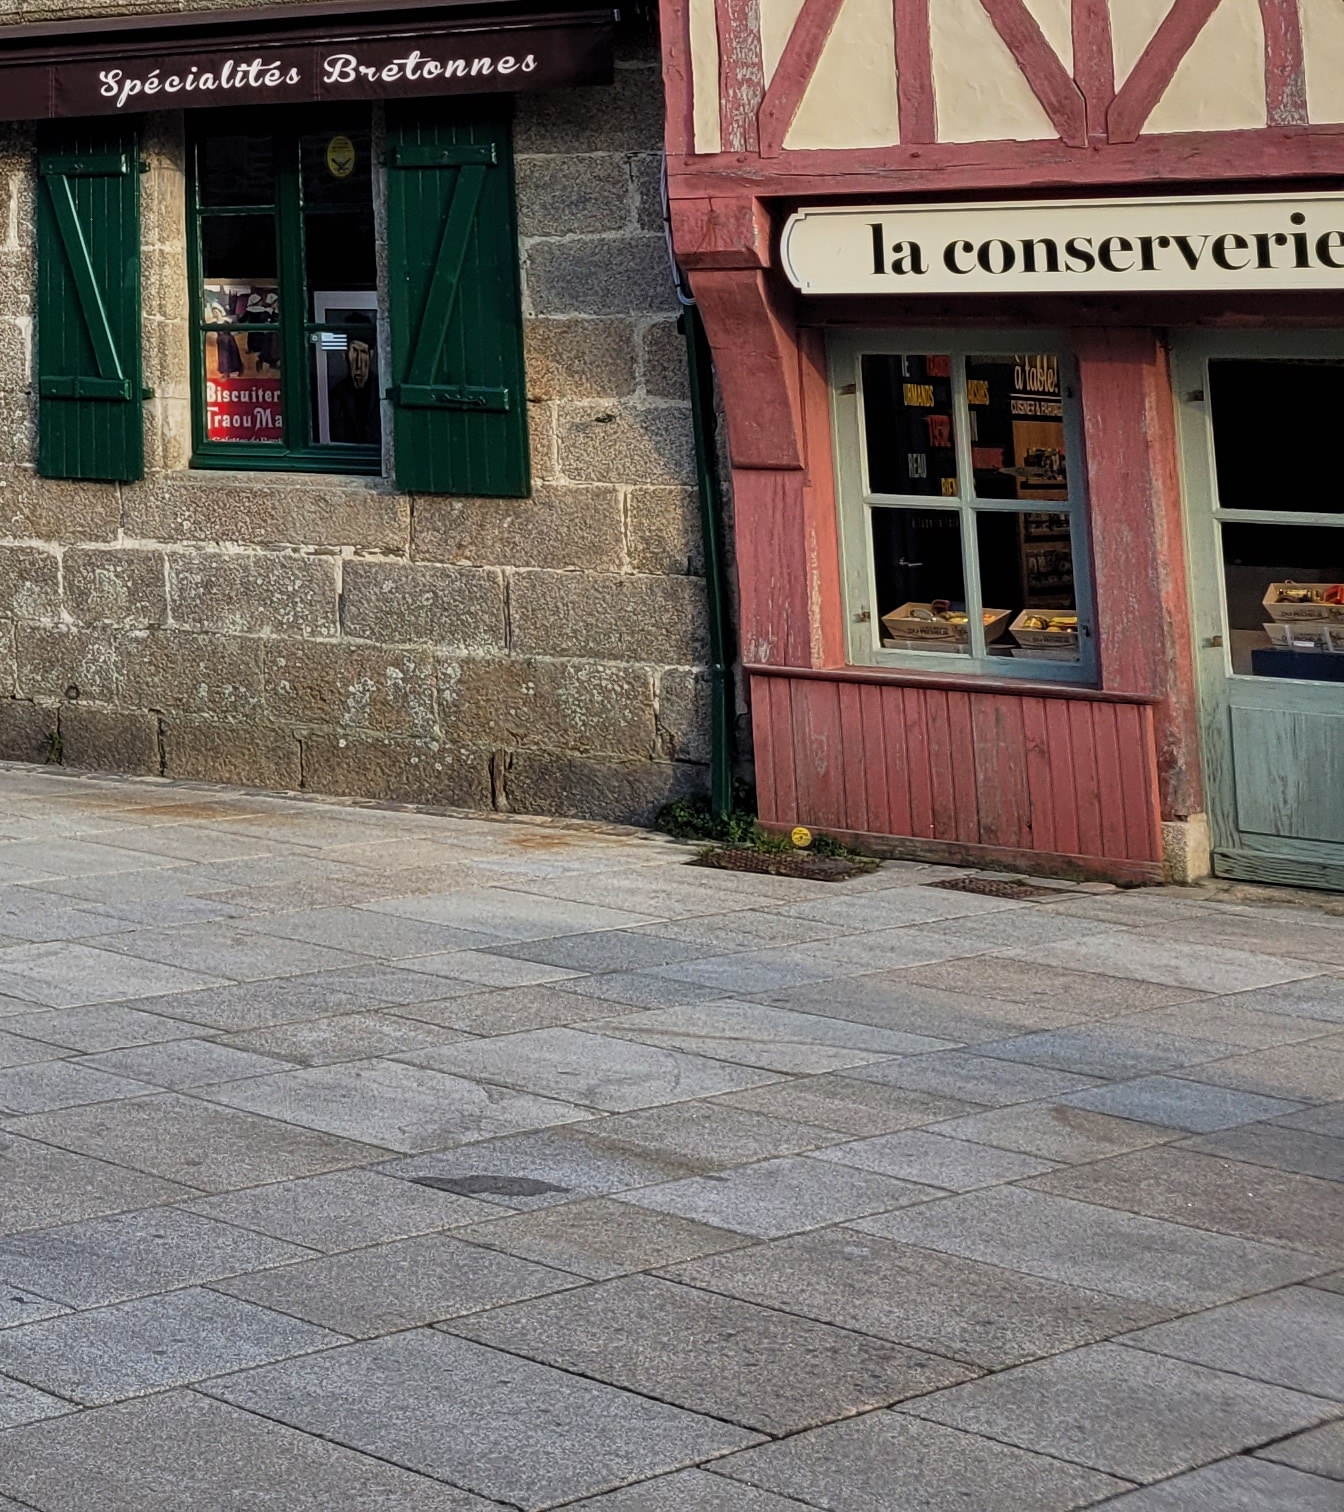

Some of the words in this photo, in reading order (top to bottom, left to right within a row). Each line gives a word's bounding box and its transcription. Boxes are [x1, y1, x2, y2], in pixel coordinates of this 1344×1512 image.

[98, 57, 301, 108] Spécialités
[323, 50, 539, 84] Bretonnes
[864, 222, 930, 276] la
[942, 211, 1344, 276] conserverie
[207, 406, 252, 430] Traou
